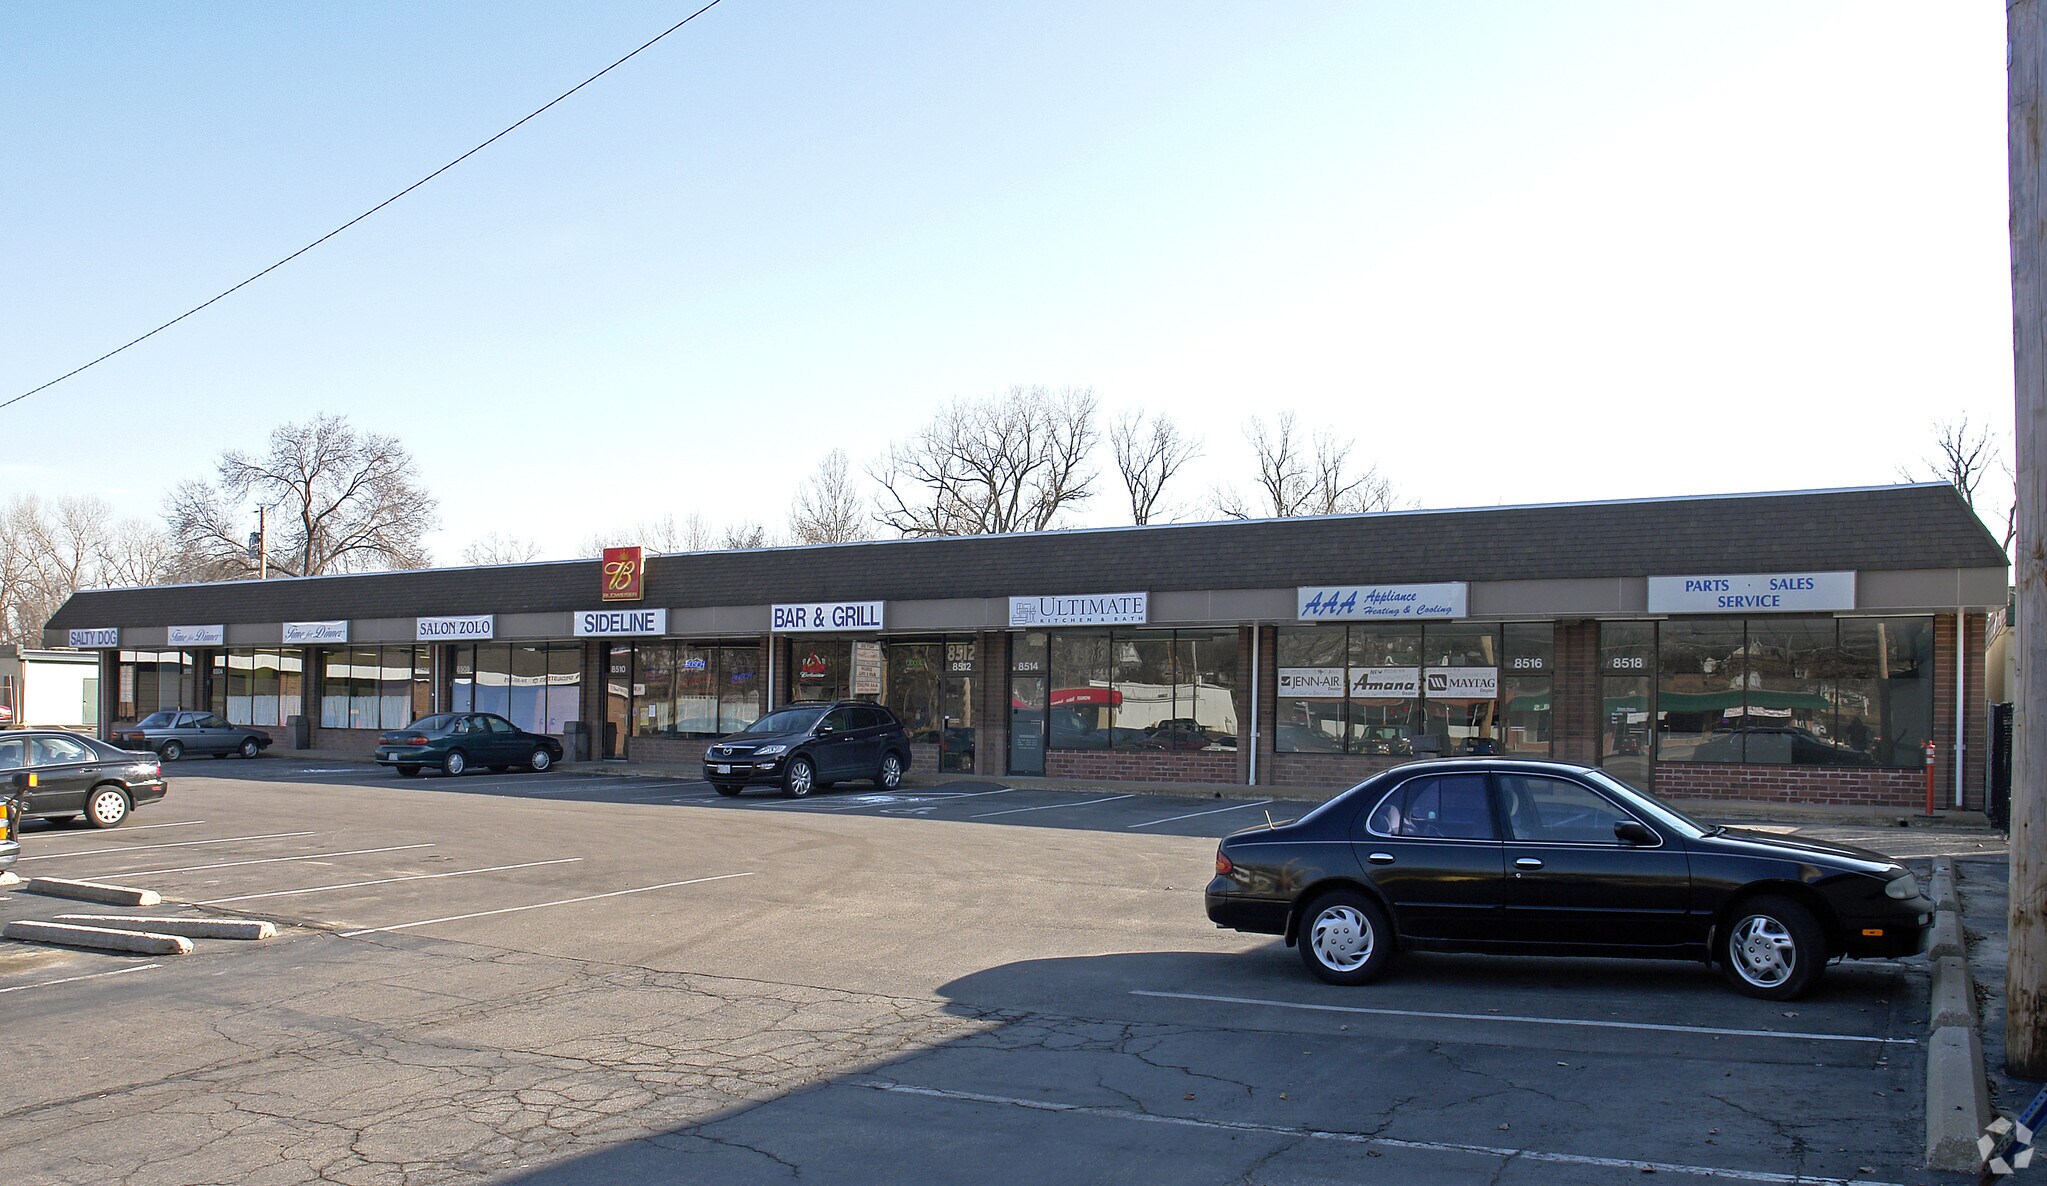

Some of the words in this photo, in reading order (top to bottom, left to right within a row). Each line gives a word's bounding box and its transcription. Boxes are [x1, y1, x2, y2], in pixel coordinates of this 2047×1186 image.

[1685, 579, 1730, 592] PARTS
[1769, 577, 1814, 590] SALES
[1301, 590, 1358, 616] AAA
[1364, 589, 1417, 605] Appliance
[1718, 595, 1780, 608] SERVICE
[1040, 597, 1144, 616] ULTIMATE
[1363, 606, 1400, 617] Heating
[1403, 605, 1411, 613] &
[1416, 604, 1452, 615] Cooling
[584, 612, 655, 633] SIDELINE
[774, 607, 806, 628] BAR
[813, 607, 825, 627] &
[832, 605, 880, 627] GRILL
[285, 625, 306, 639] Time
[315, 625, 342, 639] Dinner
[420, 622, 456, 635] SALON
[460, 620, 491, 634] ZOLO
[70, 630, 95, 646] SALTY
[97, 630, 117, 645] DOG
[169, 629, 187, 642] Time
[194, 628, 220, 642] Dinner
[947, 645, 975, 661] 8512
[611, 665, 626, 673] 8510
[952, 662, 972, 671] 8512
[1018, 662, 1039, 671] 8514
[1514, 658, 1543, 668] 8516
[1612, 657, 1643, 668] 8518
[1291, 676, 1340, 689] JENN-AIR
[1353, 674, 1415, 691] Amana
[1449, 678, 1495, 688] MAYTAG
